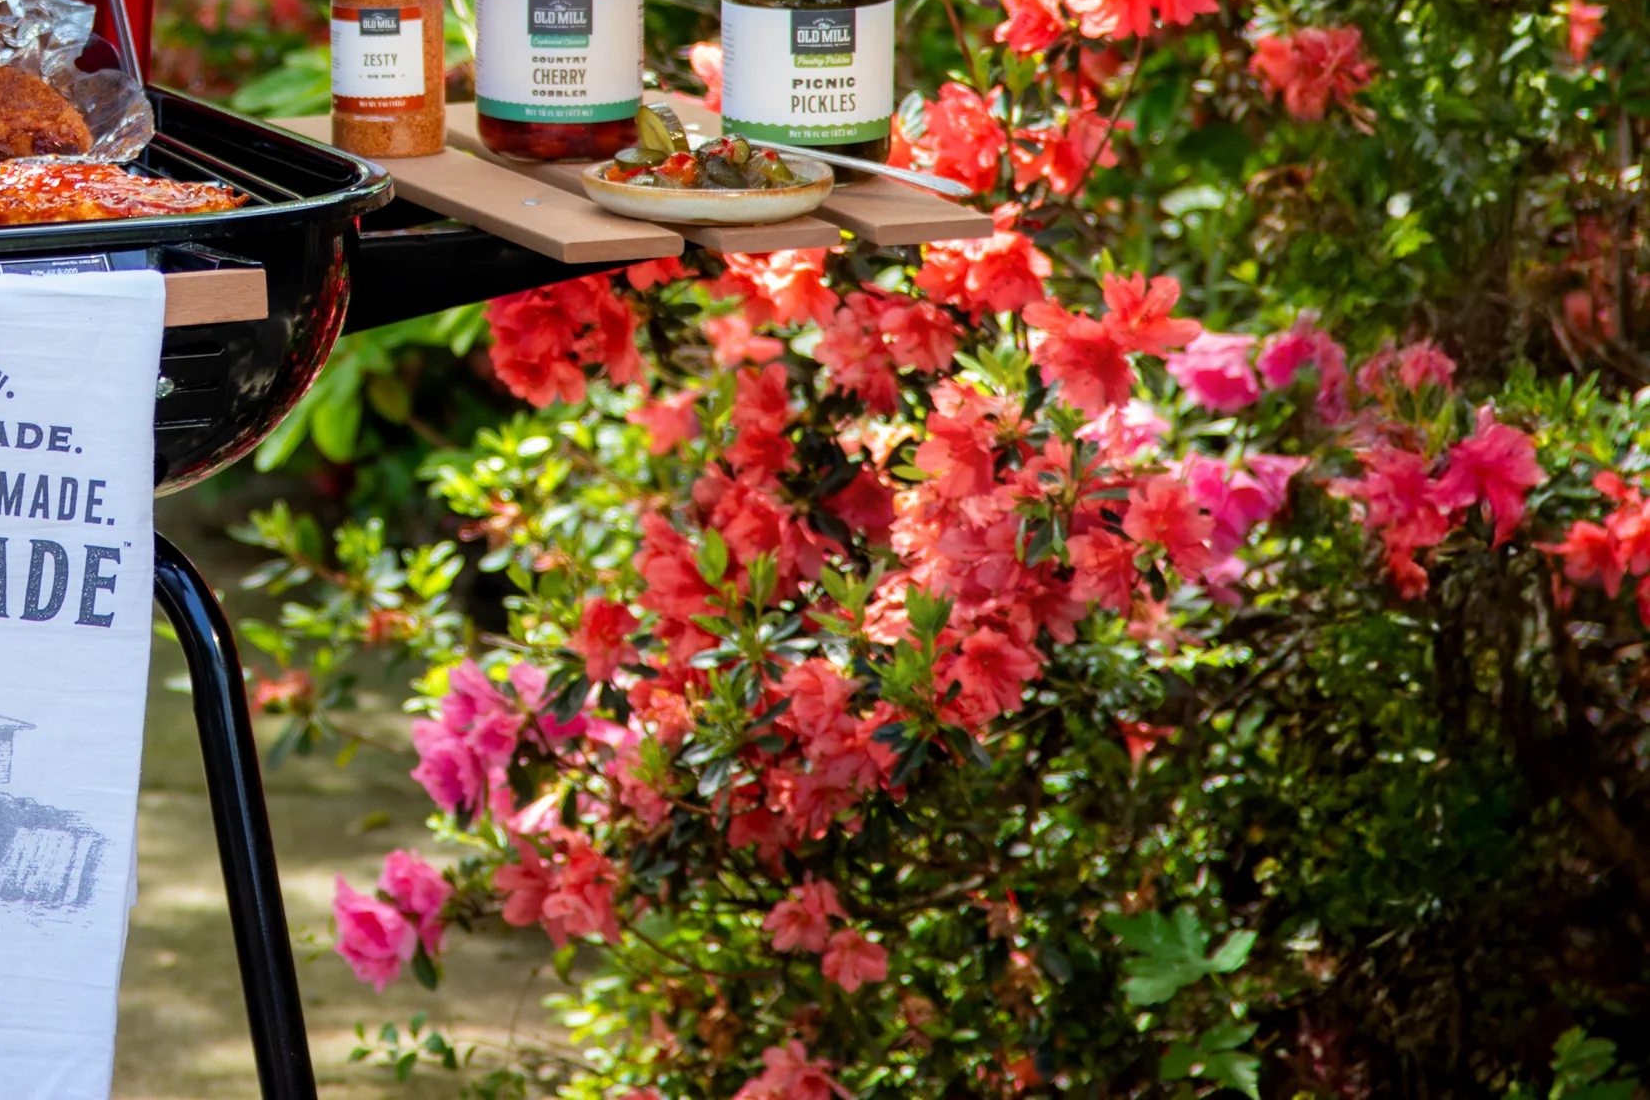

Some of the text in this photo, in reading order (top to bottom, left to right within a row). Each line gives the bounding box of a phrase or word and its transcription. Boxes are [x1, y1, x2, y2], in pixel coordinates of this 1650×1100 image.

[362, 19, 397, 29] OLD MILL
[534, 11, 586, 24] OLD MILL
[797, 29, 851, 43] OLD MILL
[363, 53, 398, 67] ZESTY
[532, 56, 587, 64] COUNTRY
[533, 68, 586, 85] CHERRY
[792, 76, 856, 89] PICNIC
[532, 89, 587, 97] COBBLER
[791, 93, 856, 113] PICKLES
